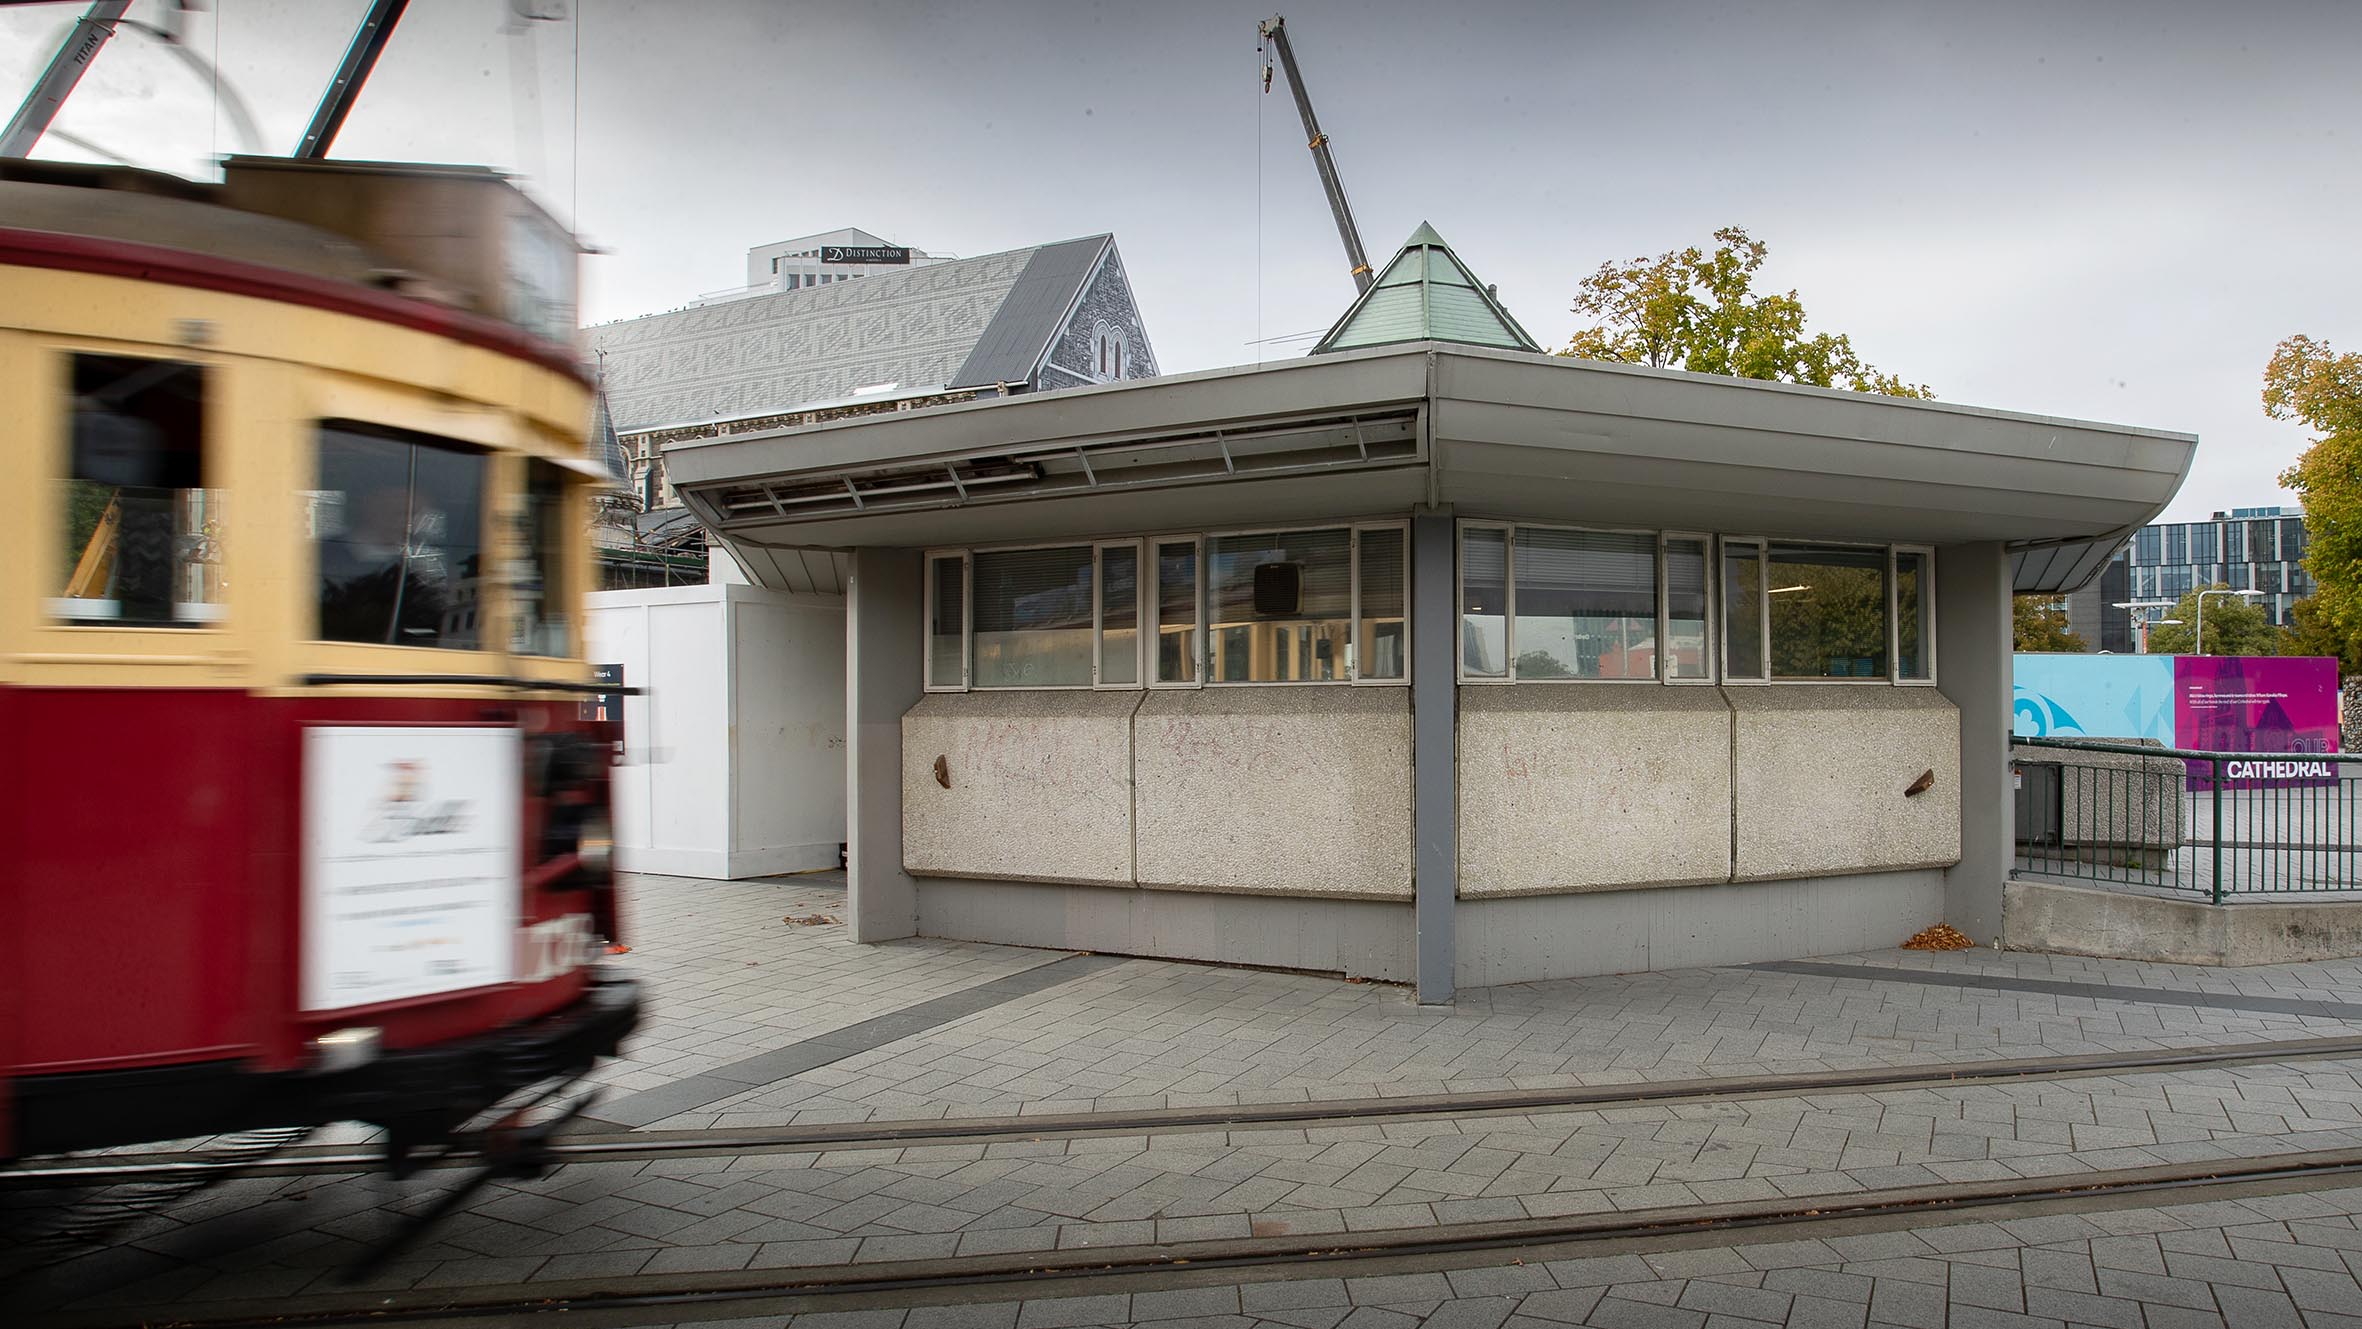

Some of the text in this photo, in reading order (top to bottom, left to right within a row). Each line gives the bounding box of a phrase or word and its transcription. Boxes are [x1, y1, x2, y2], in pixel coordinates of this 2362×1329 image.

[74, 33, 98, 65] TITAN
[846, 248, 902, 258] DISTINCTION
[2291, 738, 2329, 754] OUR
[2227, 760, 2332, 779] CATHEDRAL
